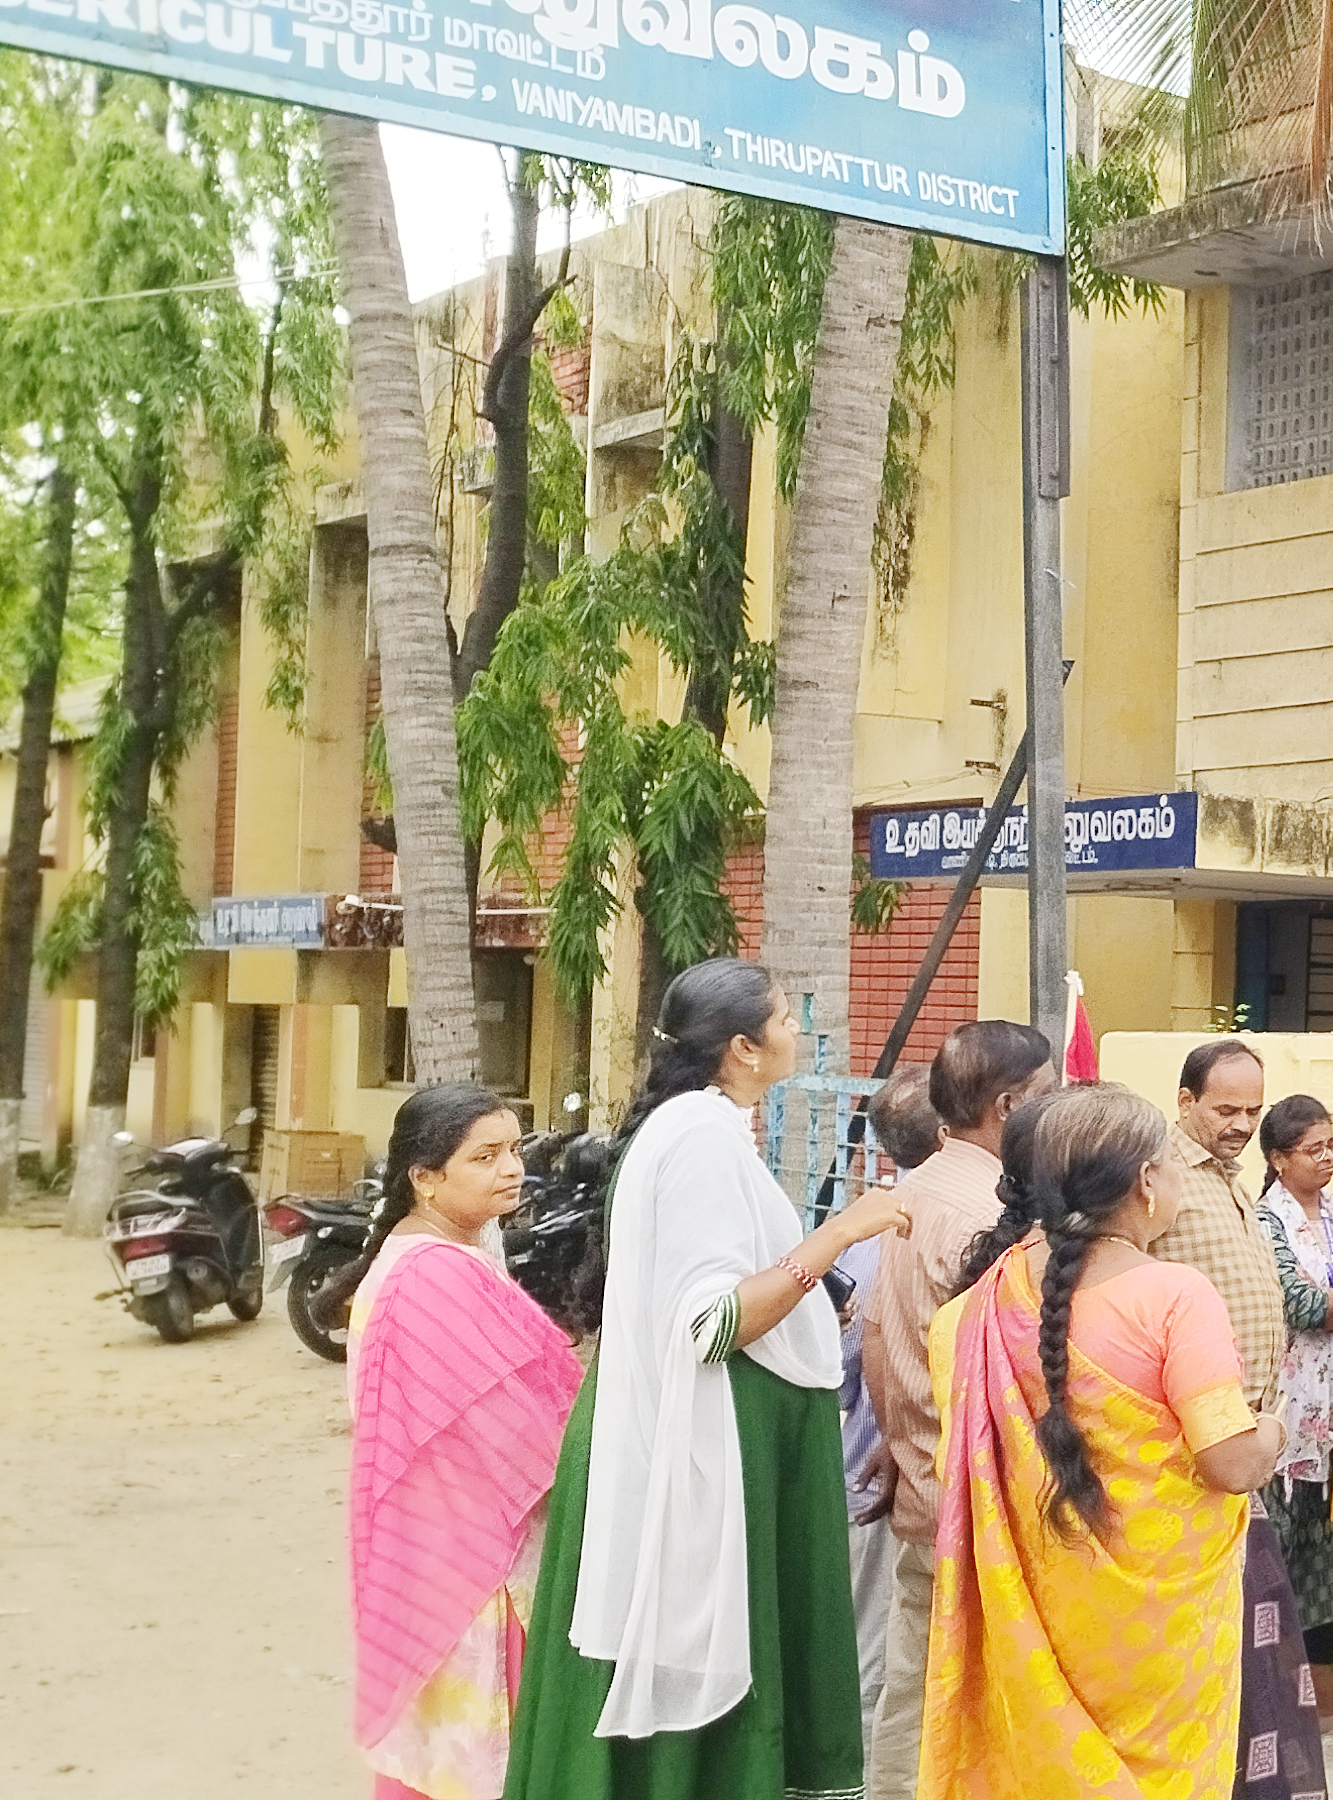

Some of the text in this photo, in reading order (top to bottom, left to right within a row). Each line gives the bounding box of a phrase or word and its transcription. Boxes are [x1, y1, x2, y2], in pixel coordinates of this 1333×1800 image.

[444, 16, 606, 81] மாவட்டம்
[505, 0, 965, 118] லுவலகம்
[0, 0, 497, 101] RICULTURE,
[724, 127, 911, 197] THIRUPATTUR
[919, 169, 1020, 219] DISTRICT
[885, 813, 940, 857] உதவி
[1064, 794, 1176, 853] லுவலகம்
